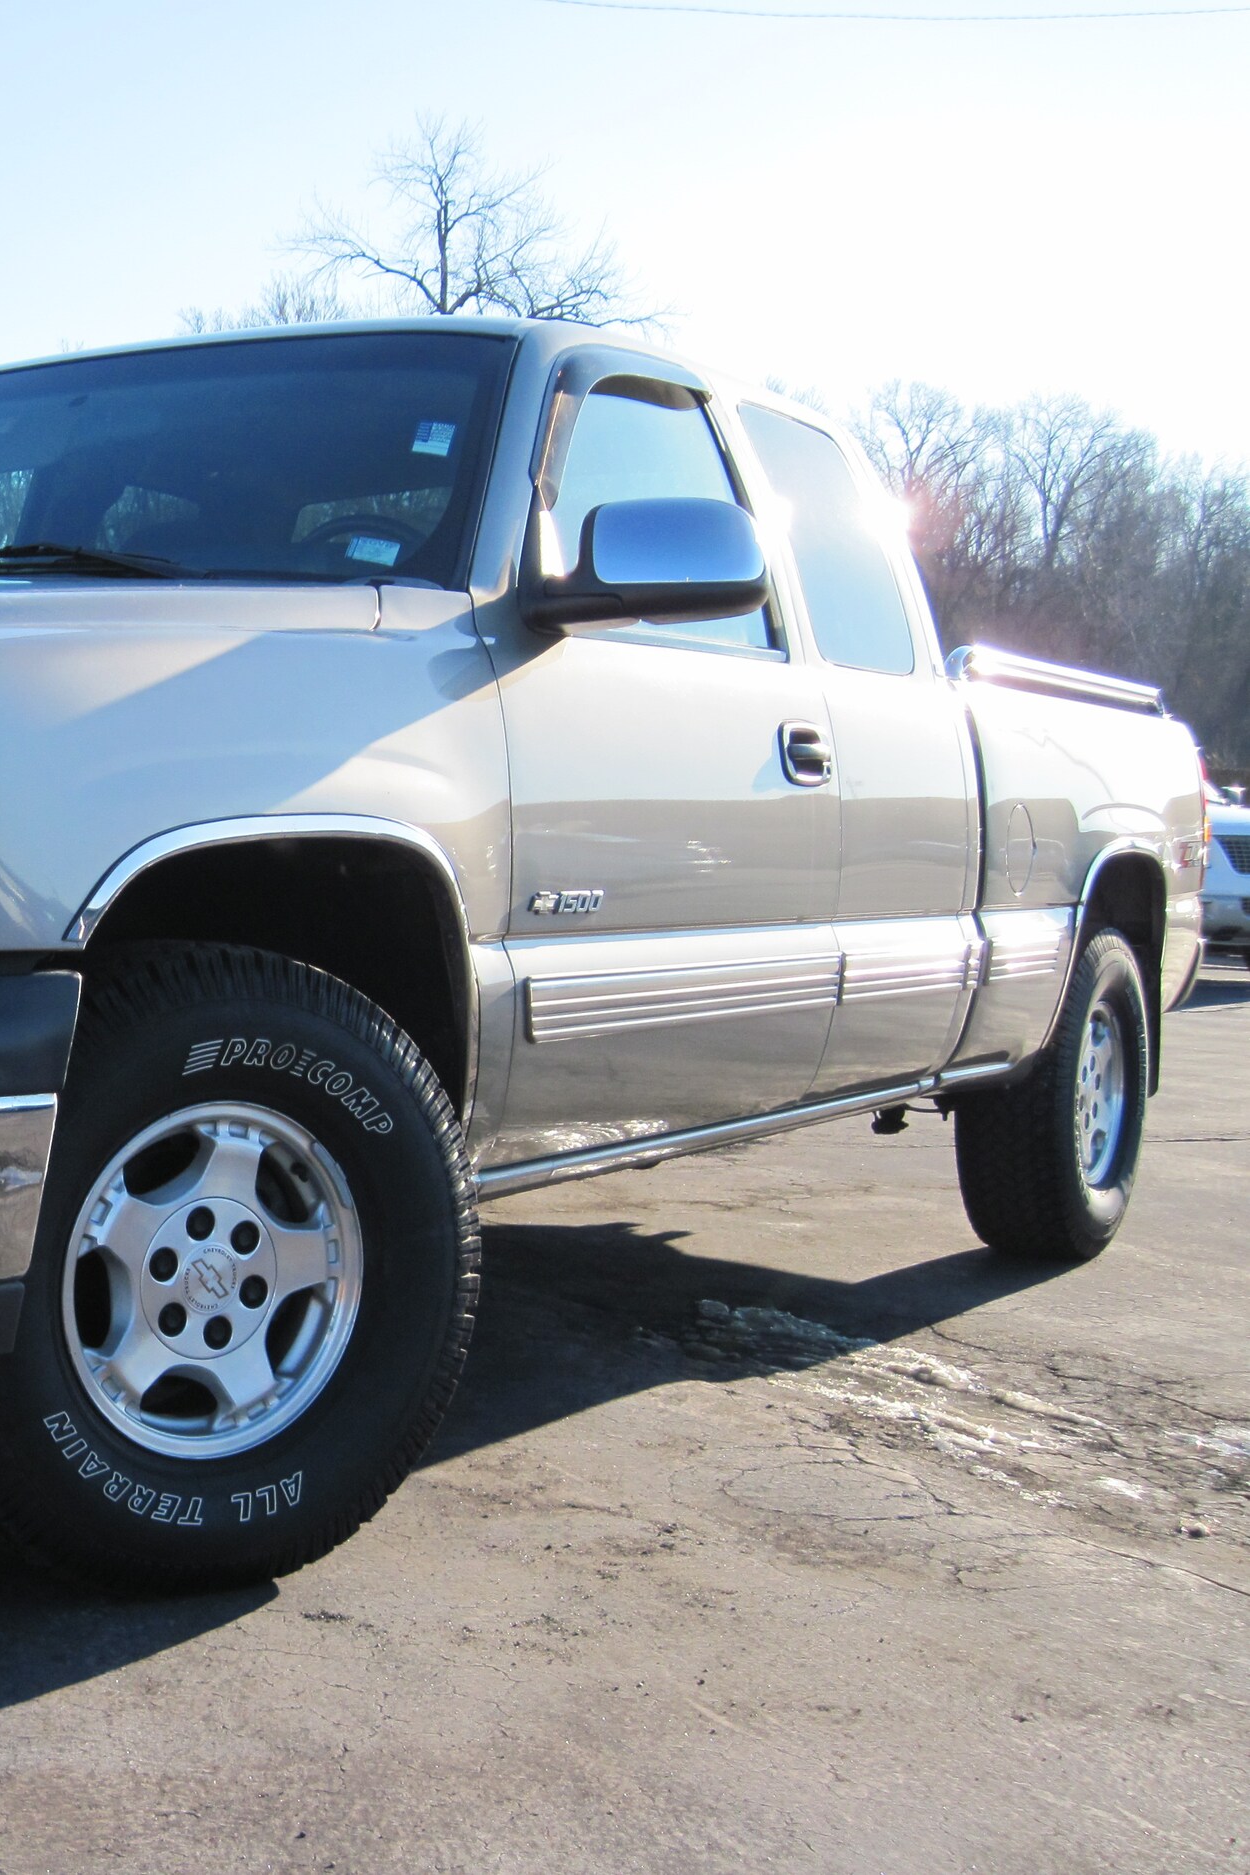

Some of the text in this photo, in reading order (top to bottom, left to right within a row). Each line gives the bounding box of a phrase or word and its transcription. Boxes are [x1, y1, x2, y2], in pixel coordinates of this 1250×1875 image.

[558, 889, 604, 913] 1500
[306, 1060, 394, 1135] COMP
[203, 1247, 233, 1261] CHEVROLET
[42, 1411, 303, 1526] ALL TERRAIN
